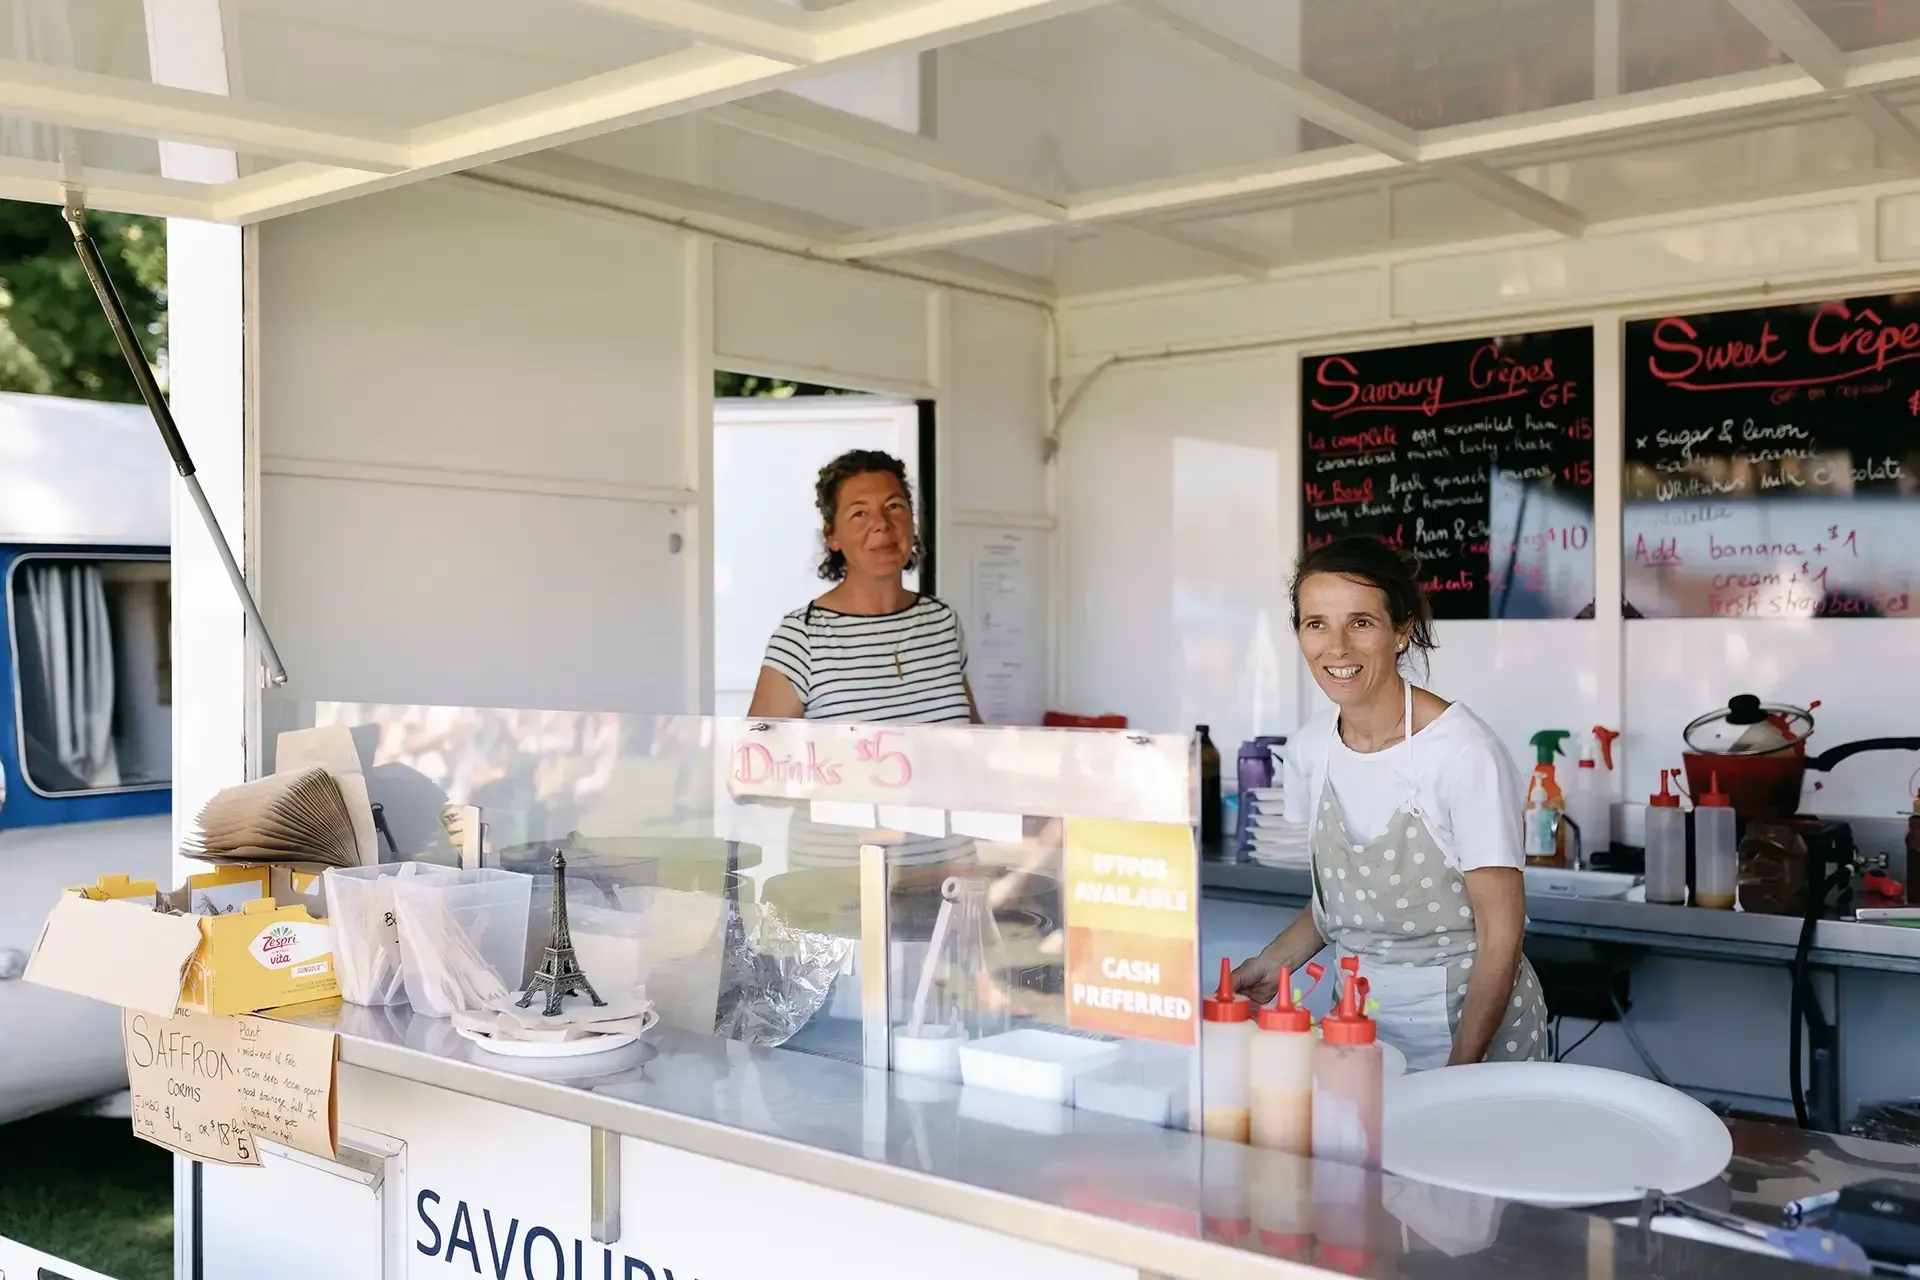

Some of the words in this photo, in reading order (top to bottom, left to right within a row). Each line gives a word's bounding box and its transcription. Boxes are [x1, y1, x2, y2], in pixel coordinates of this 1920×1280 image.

[1649, 316, 1787, 381] Sweet
[1312, 356, 1444, 416] Savoury
[1469, 344, 1555, 397] Crêpes
[1539, 381, 1578, 409] GF
[1656, 426, 1715, 458] sugar
[1718, 418, 1735, 444] &
[1743, 416, 1810, 441] lemon
[1415, 516, 1449, 544] ham
[1453, 517, 1467, 542] &
[1634, 532, 1684, 562] Add
[1709, 534, 1804, 561] banana
[1712, 569, 1782, 589] cream
[734, 740, 845, 787] Drinks
[855, 730, 914, 789] $5
[1074, 879, 1188, 913] AVAILABLE
[262, 933, 297, 952] Zespri
[270, 953, 292, 965] vita
[1101, 956, 1160, 985] CASH
[1072, 982, 1192, 1021] PREFERRED
[164, 1105, 183, 1142] $4
[199, 1124, 211, 1138] OR
[230, 1118, 246, 1138] for
[237, 1137, 250, 1159] 5
[416, 1188, 702, 1280] SAVOU
